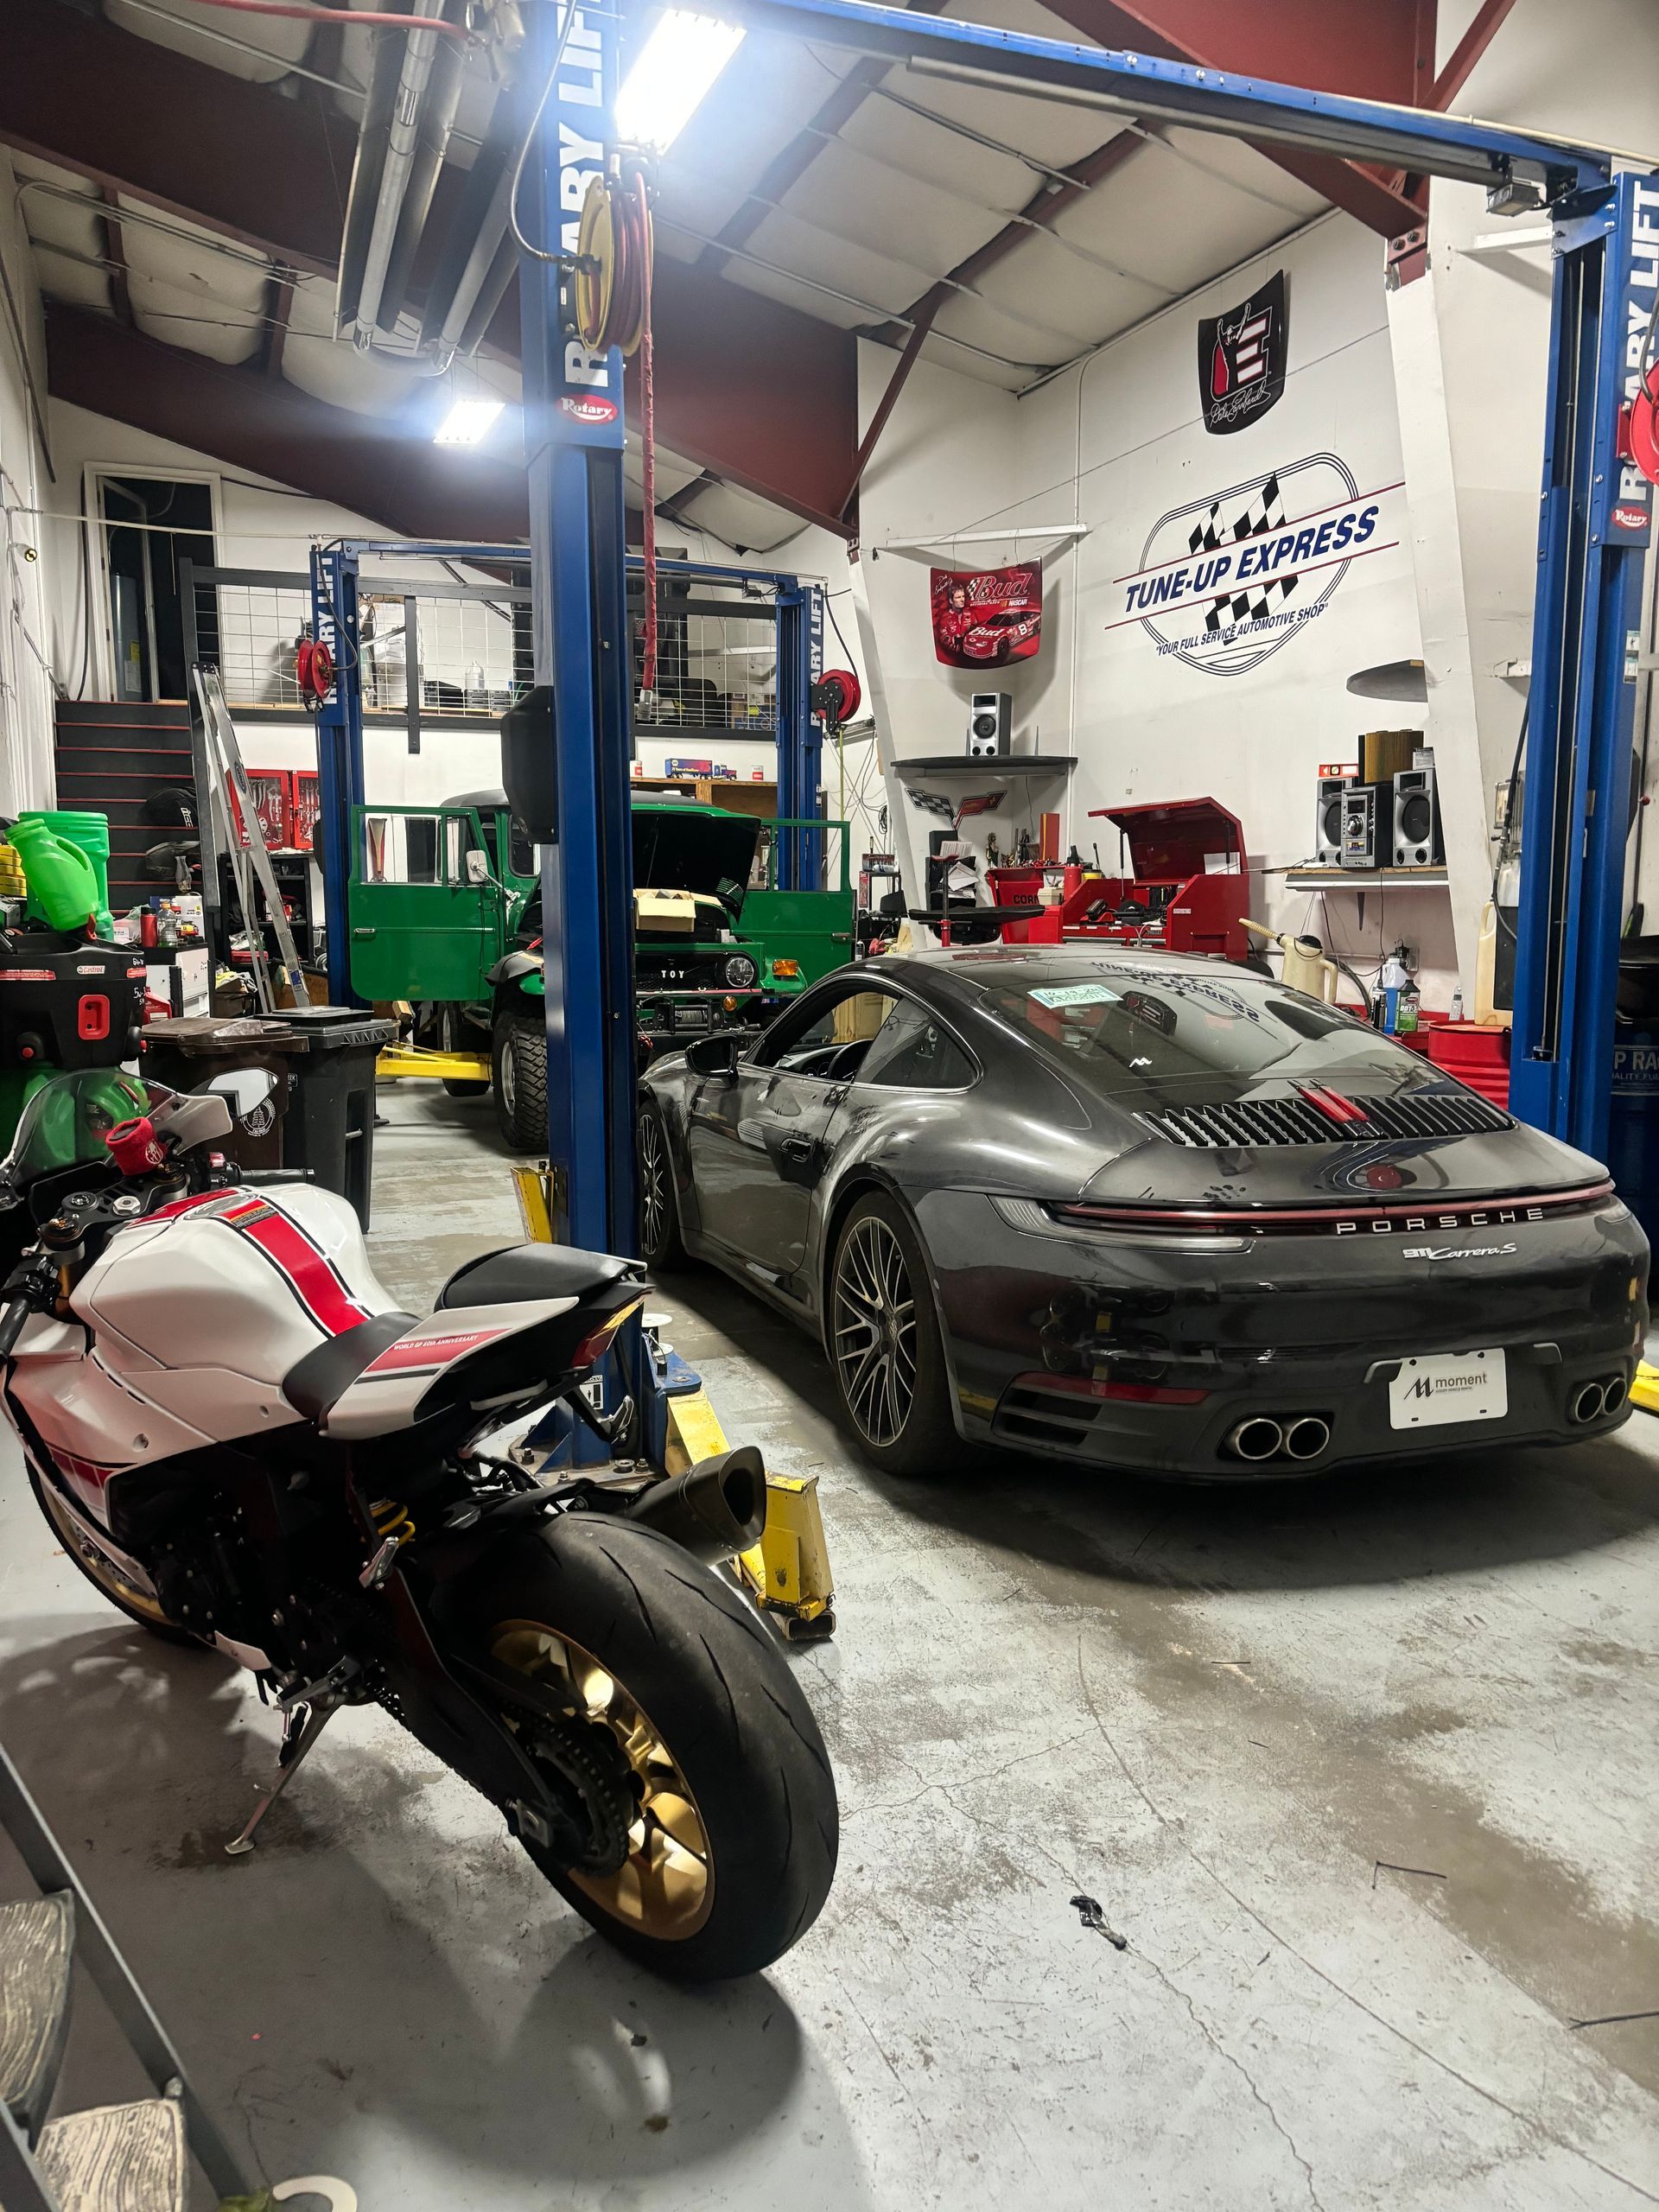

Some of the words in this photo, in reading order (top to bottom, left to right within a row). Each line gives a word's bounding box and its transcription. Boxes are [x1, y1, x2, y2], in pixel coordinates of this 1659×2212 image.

[556, 0, 603, 107] LIF
[1630, 181, 1659, 288] LIFT
[559, 122, 608, 387] RARY
[562, 397, 613, 420] Rotary
[1618, 300, 1656, 500] RARY
[1615, 509, 1648, 526] Rotary
[1125, 556, 1232, 613] TUNE-UP
[1236, 505, 1380, 581] EXPRESS
[973, 573, 1033, 601] Bud
[810, 589, 822, 635] LIFT
[969, 626, 1004, 637] Bud
[1018, 623, 1027, 636] 8
[1180, 635, 1199, 651] FULL
[1200, 625, 1236, 645] SERVICE
[1236, 611, 1296, 636] AUTOMOTIVE
[810, 640, 822, 727] RARY
[661, 969, 685, 979] TOY
[1632, 1051, 1659, 1071] RA
[1336, 1208, 1544, 1235] PORSCHE
[1402, 1247, 1433, 1259] 911
[1428, 1247, 1501, 1261] Carrera
[394, 1342, 415, 1351] WORLD
[436, 1335, 479, 1345] ANNIVERSARY
[1435, 1373, 1487, 1388] moment
